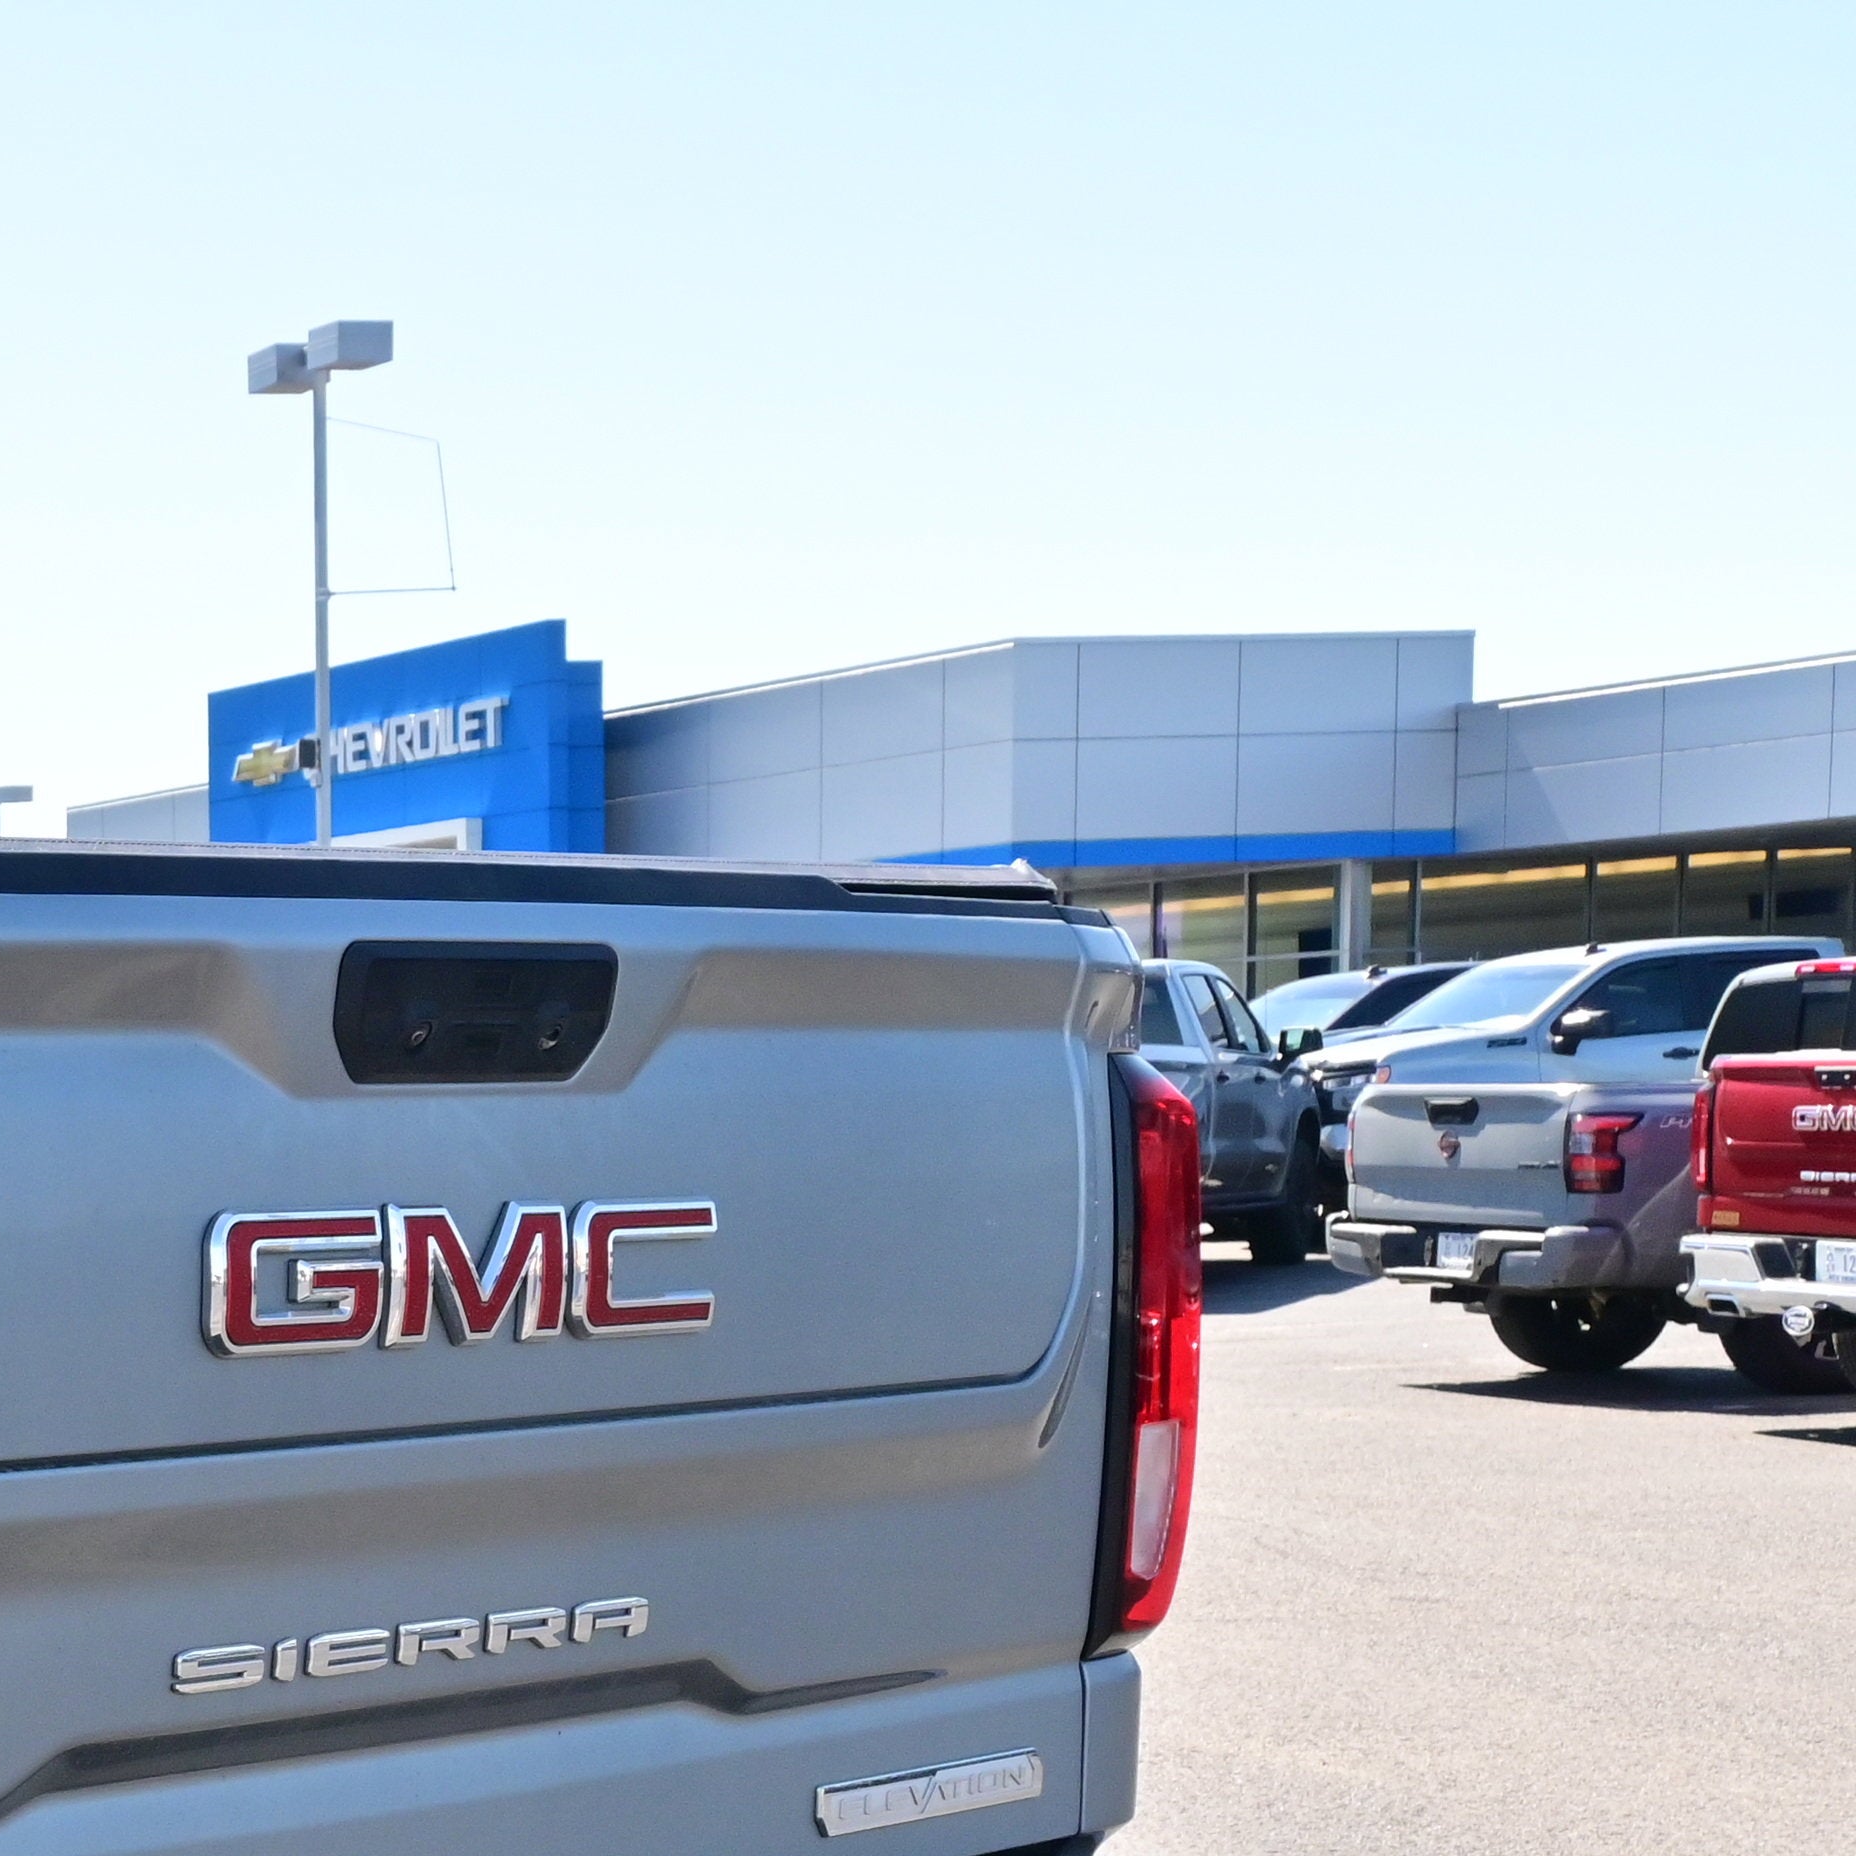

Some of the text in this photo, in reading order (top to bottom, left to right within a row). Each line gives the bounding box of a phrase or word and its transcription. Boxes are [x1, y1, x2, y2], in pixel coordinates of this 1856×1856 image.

[310, 697, 510, 778] HEVROLET
[1792, 1104, 1856, 1131] GM
[201, 1200, 718, 1359] GMC
[171, 1595, 650, 1695] SIERRA
